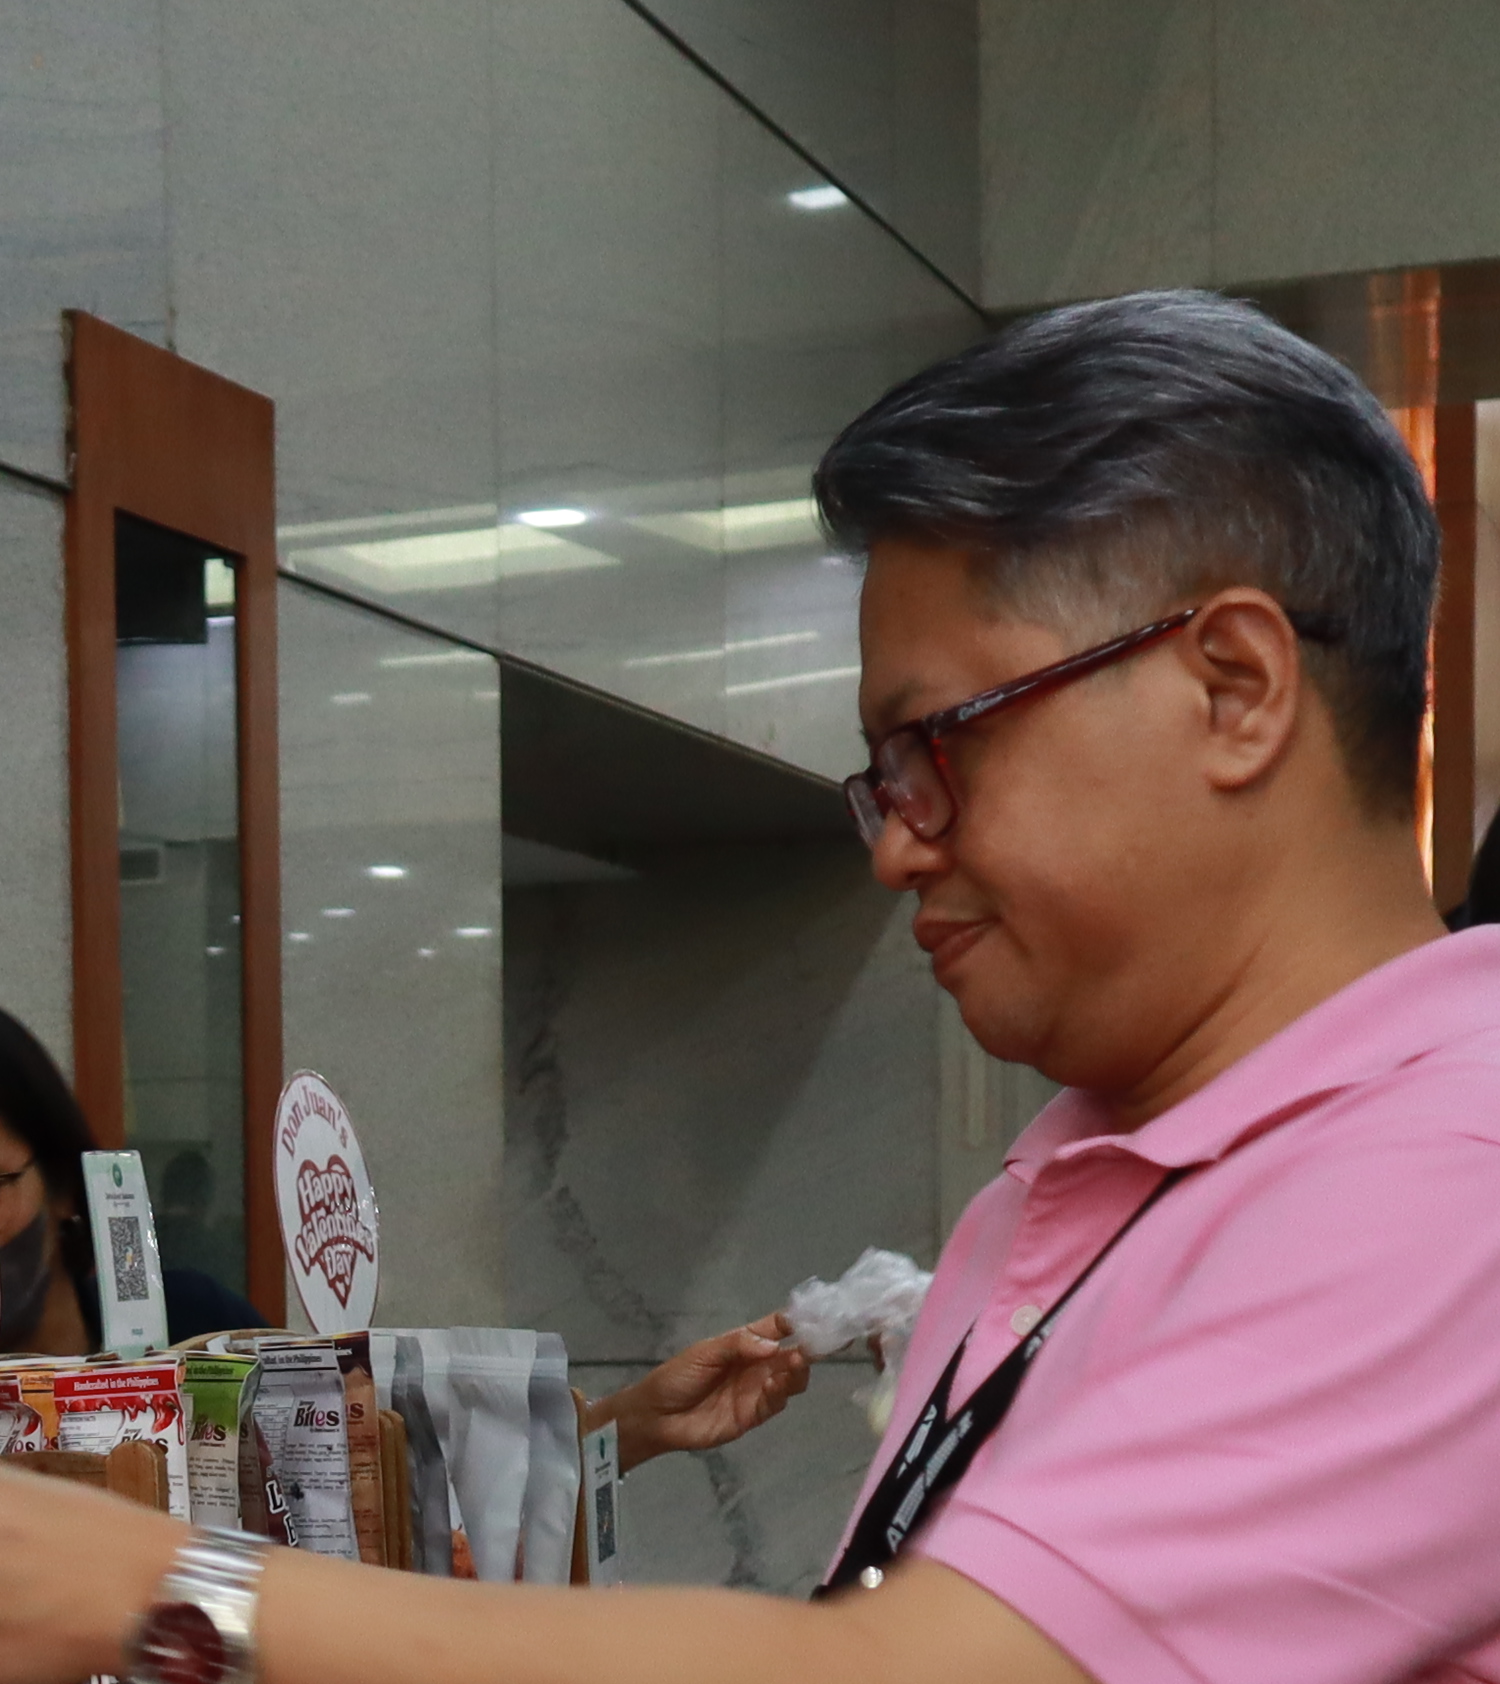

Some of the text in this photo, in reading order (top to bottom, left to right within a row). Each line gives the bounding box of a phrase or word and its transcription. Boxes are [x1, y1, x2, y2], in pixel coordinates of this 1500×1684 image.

[281, 1084, 348, 1160] Don Juan's
[298, 1167, 356, 1216] Happy
[322, 1251, 353, 1287] Day
[294, 1402, 340, 1427] Bites
